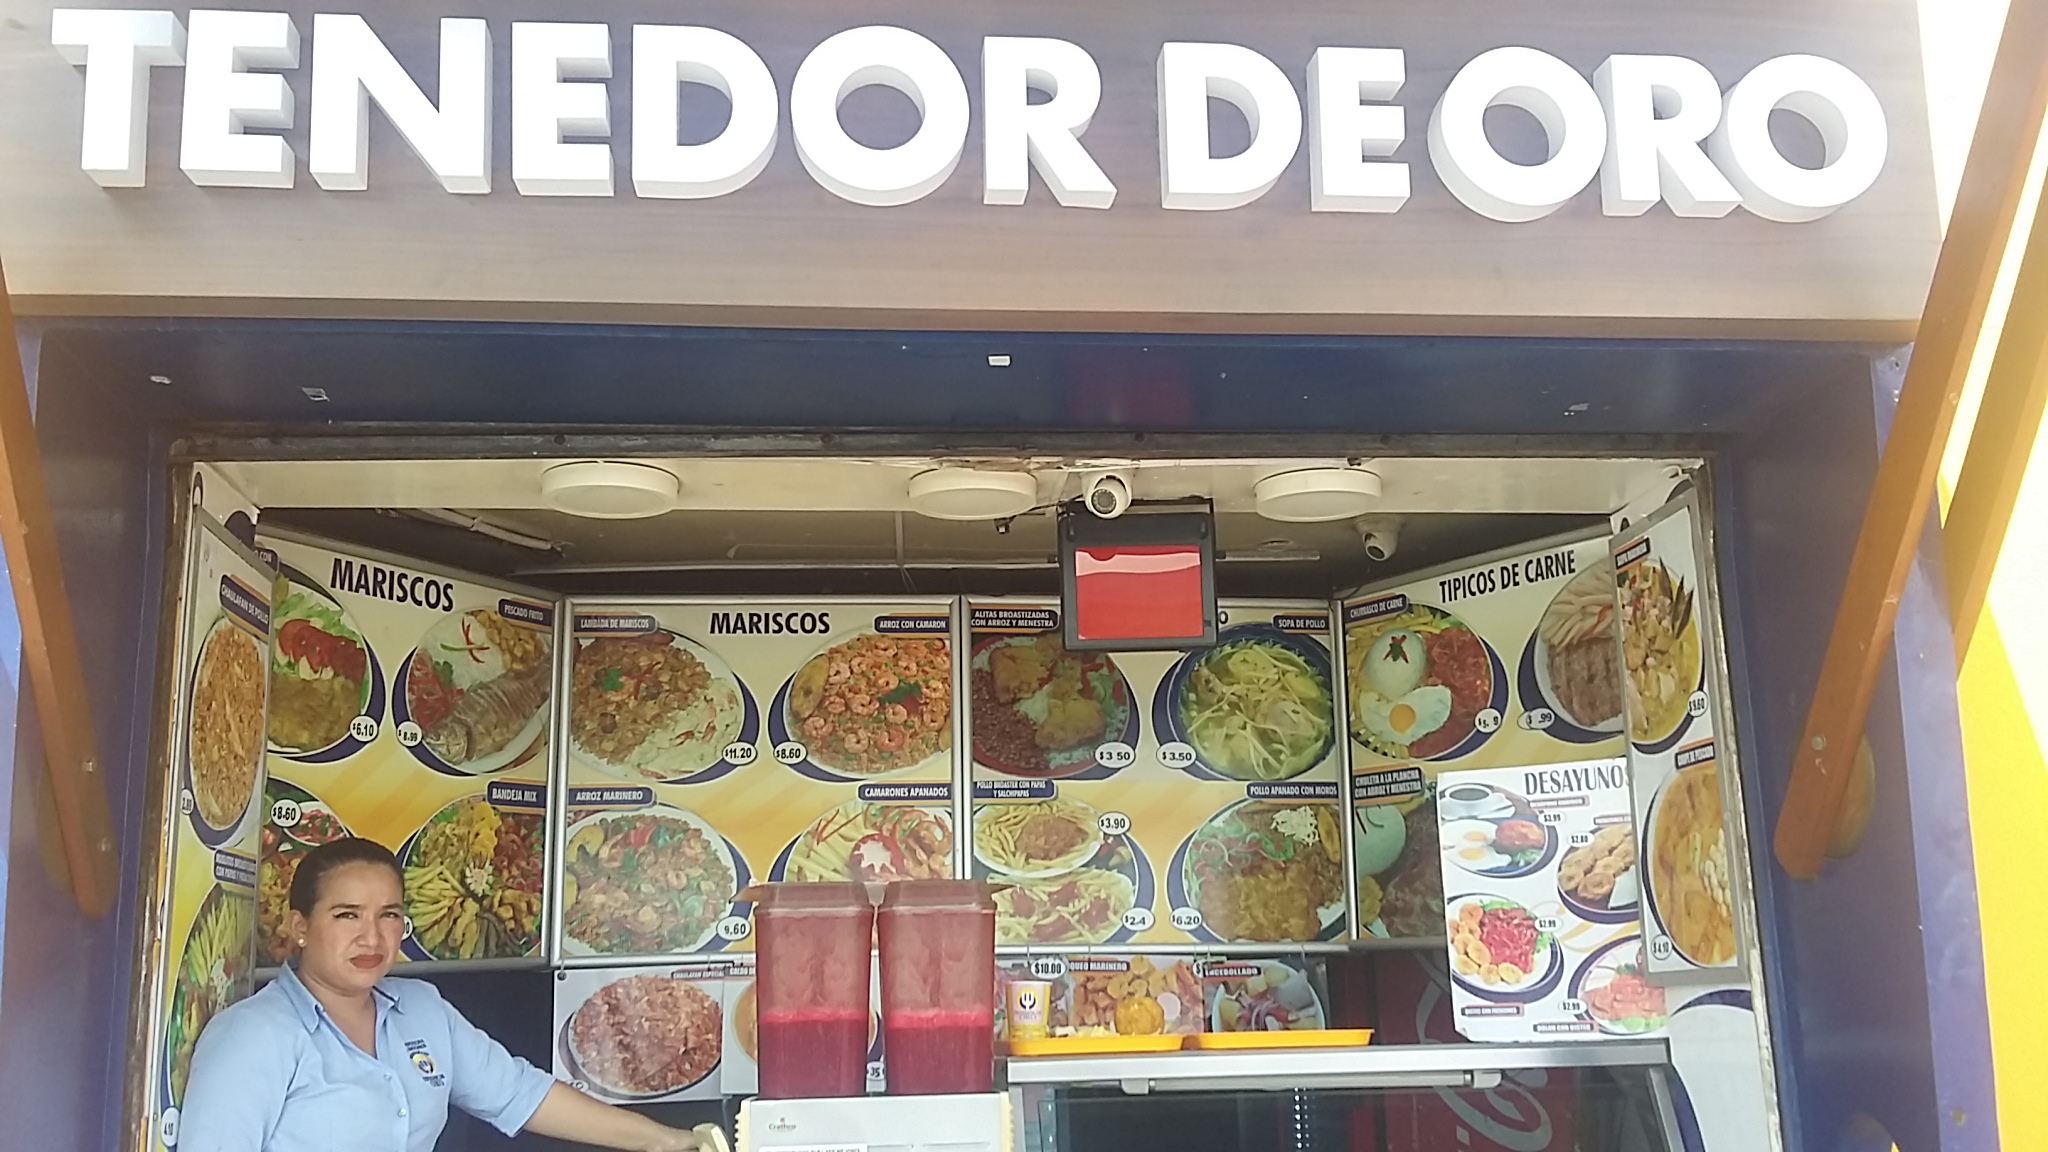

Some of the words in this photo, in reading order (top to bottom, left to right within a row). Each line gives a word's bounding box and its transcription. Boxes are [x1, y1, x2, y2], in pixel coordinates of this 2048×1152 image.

[50, 8, 1117, 207] TENEDOR
[1157, 42, 1411, 212] DE
[1428, 46, 1888, 223] ORO
[1439, 569, 1496, 603] TIPICOS
[1500, 563, 1520, 589] DE
[1524, 549, 1576, 583] CARNE
[330, 557, 454, 612] MARISCOS
[1379, 601, 1386, 611] DE
[504, 604, 528, 618] PESCADO
[528, 608, 544, 621] FRITO
[974, 610, 997, 618] ALITAS
[610, 619, 618, 628] DE
[620, 619, 649, 628] MARISCOS
[710, 612, 830, 634] MARISCOS
[880, 620, 900, 629] ARROZ
[901, 620, 914, 629] CON
[916, 620, 947, 629] CAMARON
[971, 619, 986, 627] CON
[987, 619, 1011, 627] ARROZ
[1012, 619, 1018, 627] Y
[1018, 619, 1054, 627] MENESTRA
[1278, 619, 1295, 628] SOPA
[1296, 619, 1304, 628] DE
[1305, 619, 1326, 628] POLLO
[352, 722, 374, 737] $6.10
[725, 747, 752, 759] $11.20
[776, 748, 801, 759] $8.60
[976, 781, 992, 789] POLLO
[1019, 781, 1030, 789] CON
[1031, 781, 1046, 789] PAPAS
[1525, 765, 1629, 795] DESAYUNO
[492, 787, 522, 801] BANDEJA
[523, 791, 537, 802] MIX
[576, 791, 601, 801] ARROZ
[602, 790, 643, 800] MARINERO
[864, 787, 909, 797] CAMARONES
[909, 787, 948, 797] APANADOS
[998, 789, 1029, 797] SALCHIPAPAS
[1250, 786, 1270, 795] POLLO
[1270, 786, 1299, 795] APANADO
[1300, 786, 1314, 795] CON
[272, 806, 296, 821] $8.60
[1100, 817, 1125, 829] $3.90
[1172, 915, 1200, 925] $6.20
[724, 923, 746, 935] 9.60
[1034, 963, 1062, 974] $10.00
[1090, 962, 1127, 970] MARINERO
